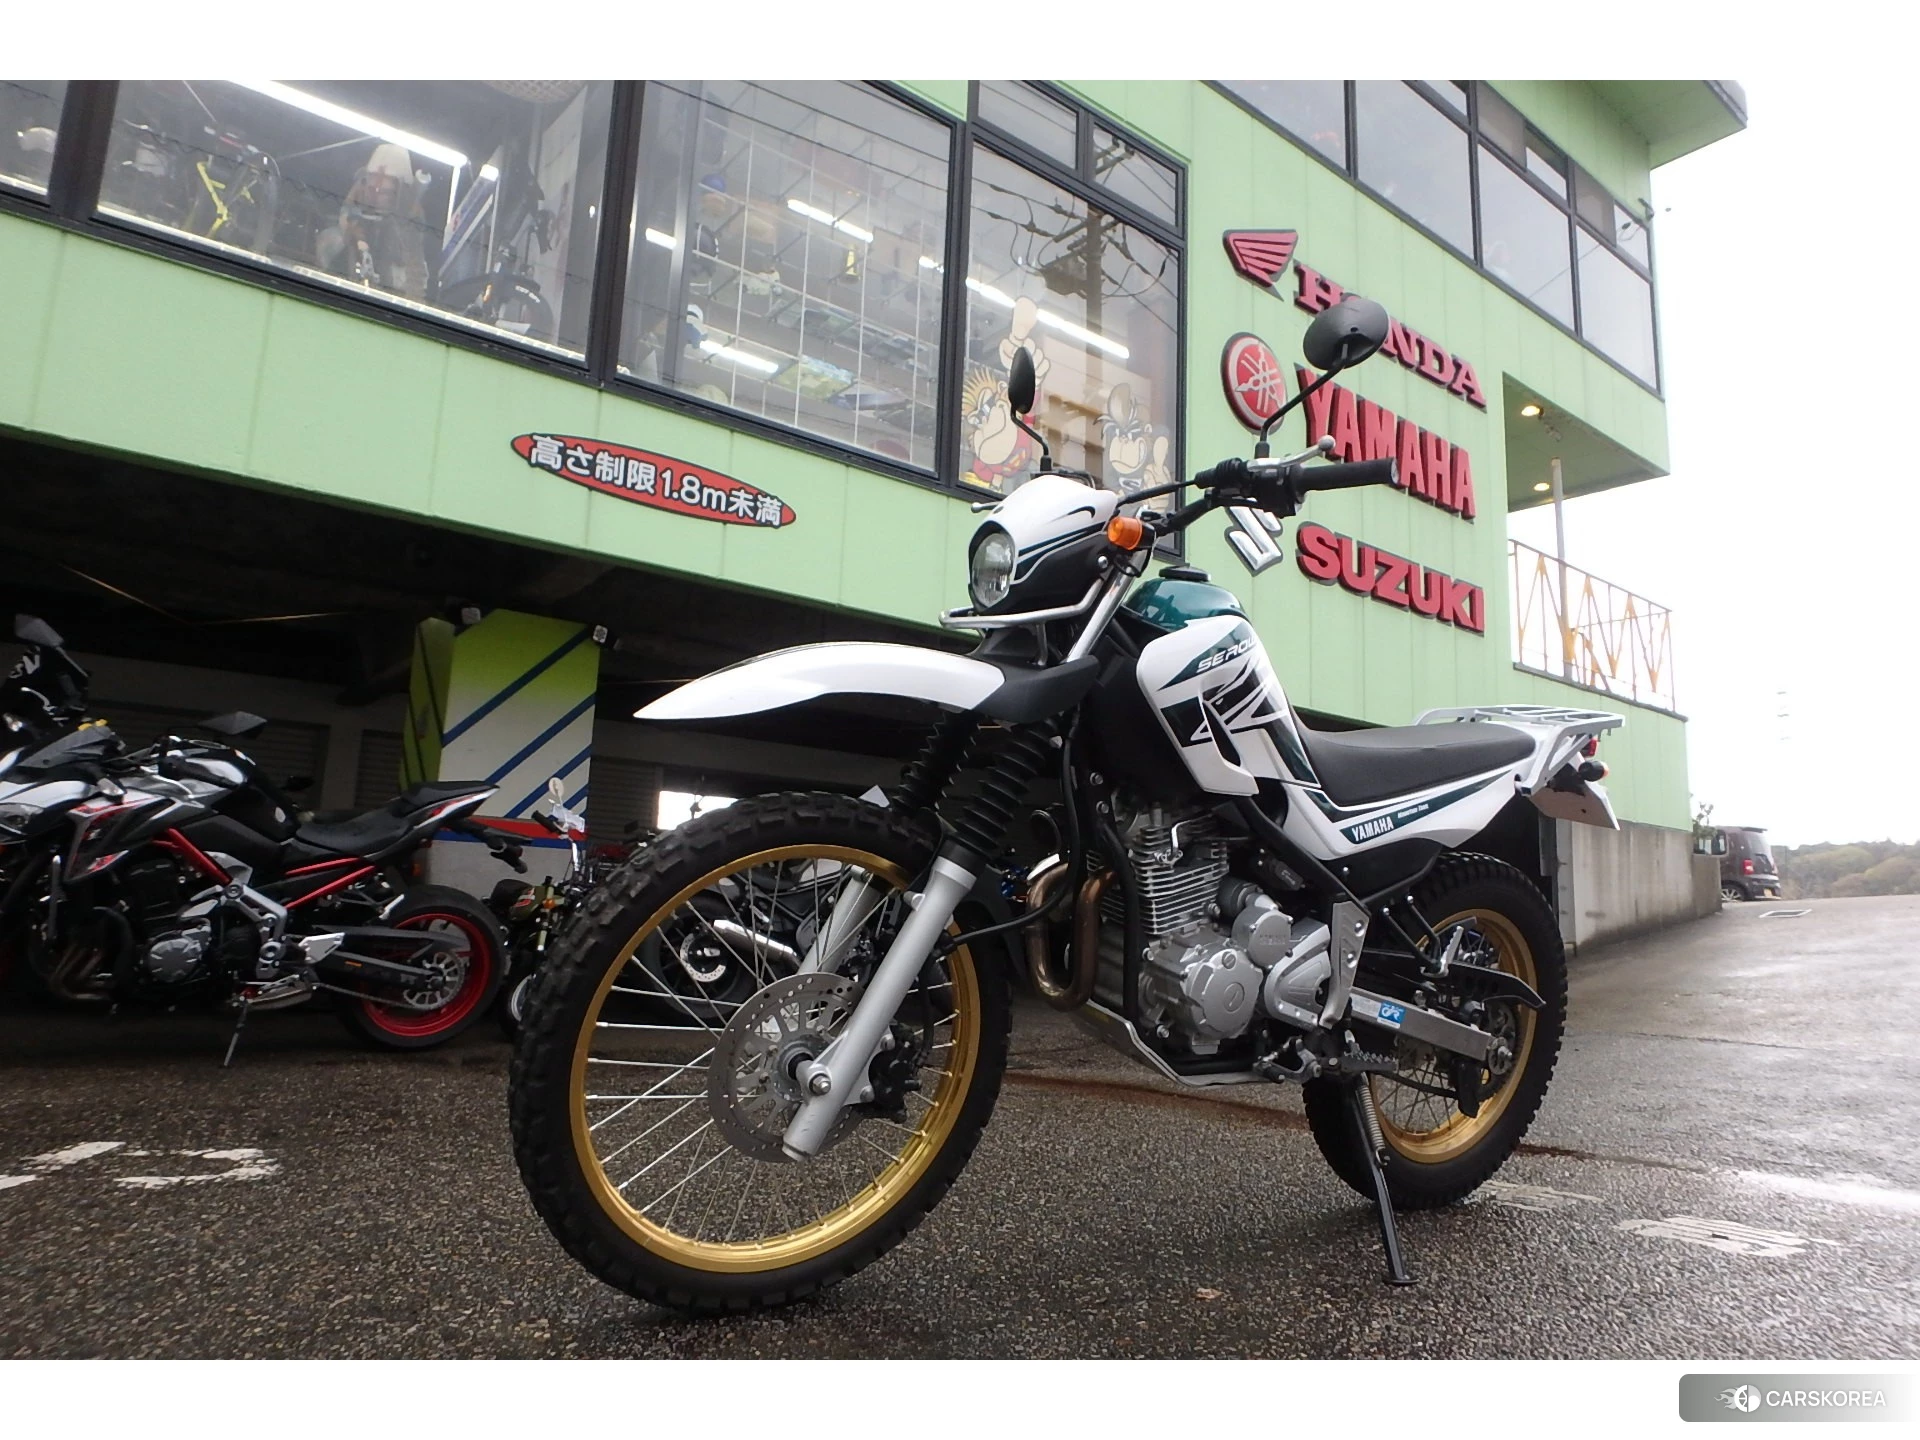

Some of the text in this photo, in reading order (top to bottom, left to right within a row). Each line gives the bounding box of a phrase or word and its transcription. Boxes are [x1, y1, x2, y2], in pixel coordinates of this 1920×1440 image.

[1295, 264, 1487, 409] HNDA
[530, 434, 783, 526] 高さ制限1.8m未満
[1296, 367, 1476, 520] YAMAHA
[1297, 524, 1485, 633] SUZUKI
[1351, 816, 1394, 842] YAMAHA
